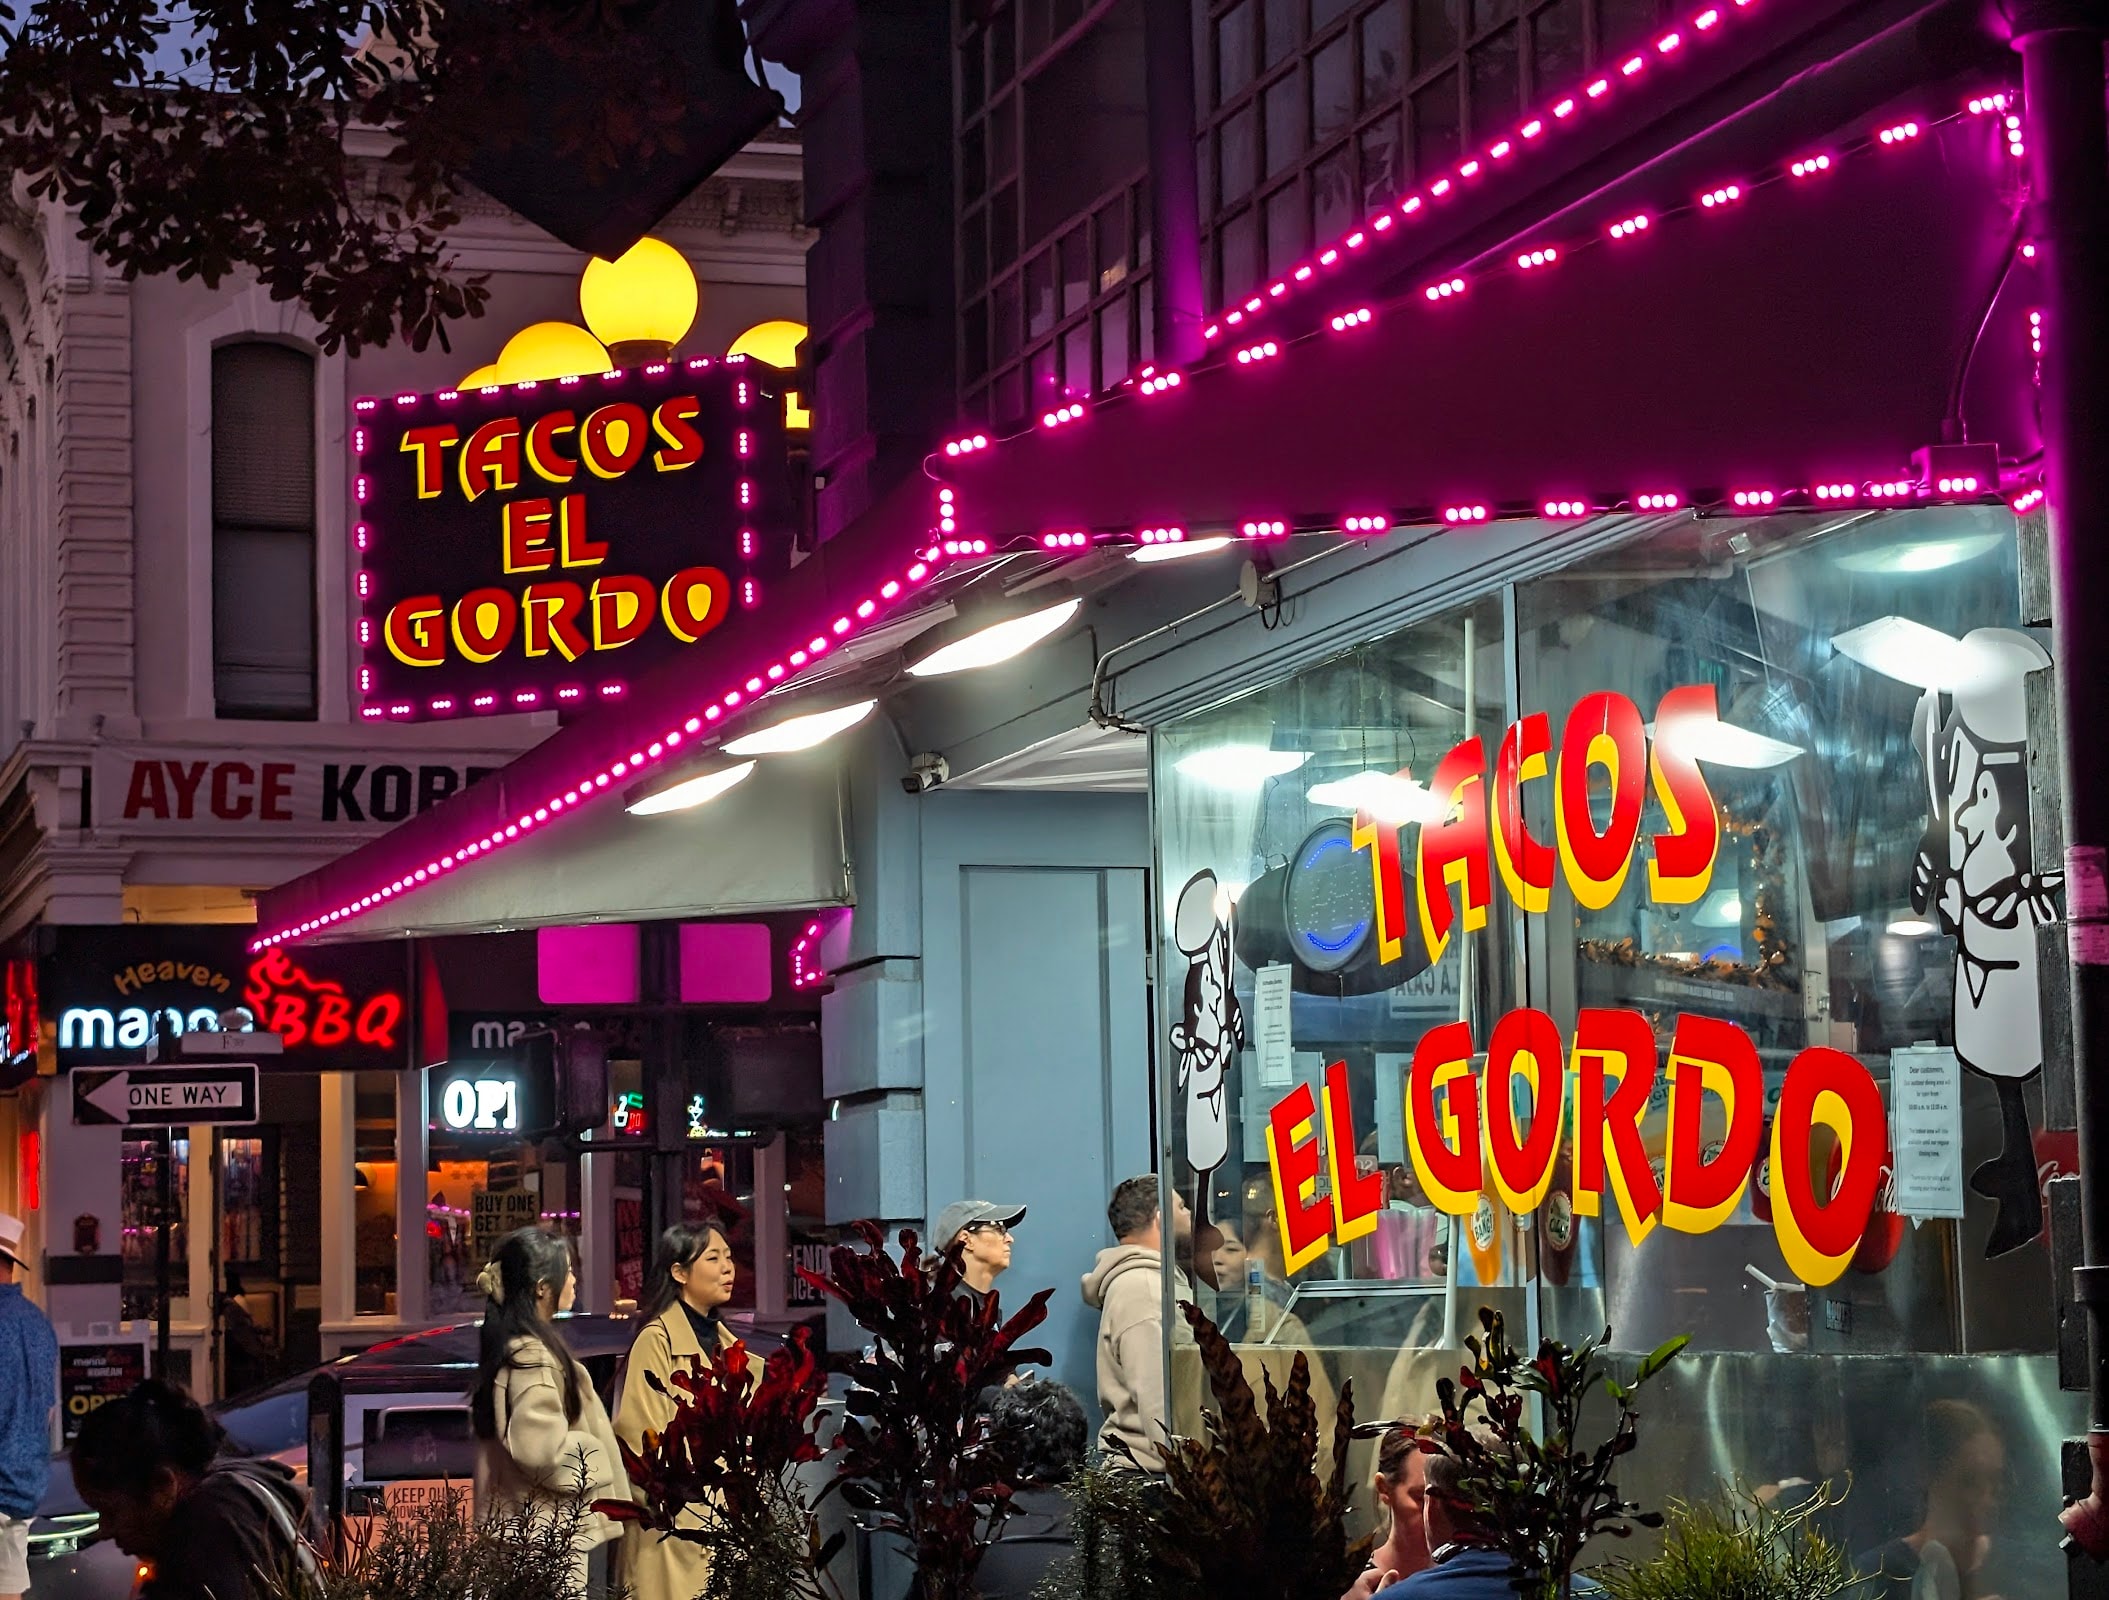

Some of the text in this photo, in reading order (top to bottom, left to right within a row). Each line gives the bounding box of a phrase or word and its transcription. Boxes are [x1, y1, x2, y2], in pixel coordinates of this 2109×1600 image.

[400, 396, 704, 502] TACOS
[503, 494, 609, 574] EL
[385, 566, 731, 666] GORDO
[123, 760, 503, 821] AYCE KOR
[1352, 684, 1720, 965] TACOS
[113, 960, 231, 996] Heaven
[269, 993, 401, 1048] BBQ
[129, 1086, 227, 1106] ONE WAY
[1266, 1007, 1889, 1287] EL GORDO
[475, 1195, 535, 1212] BUY ONE
[393, 1487, 425, 1503] KEEP
